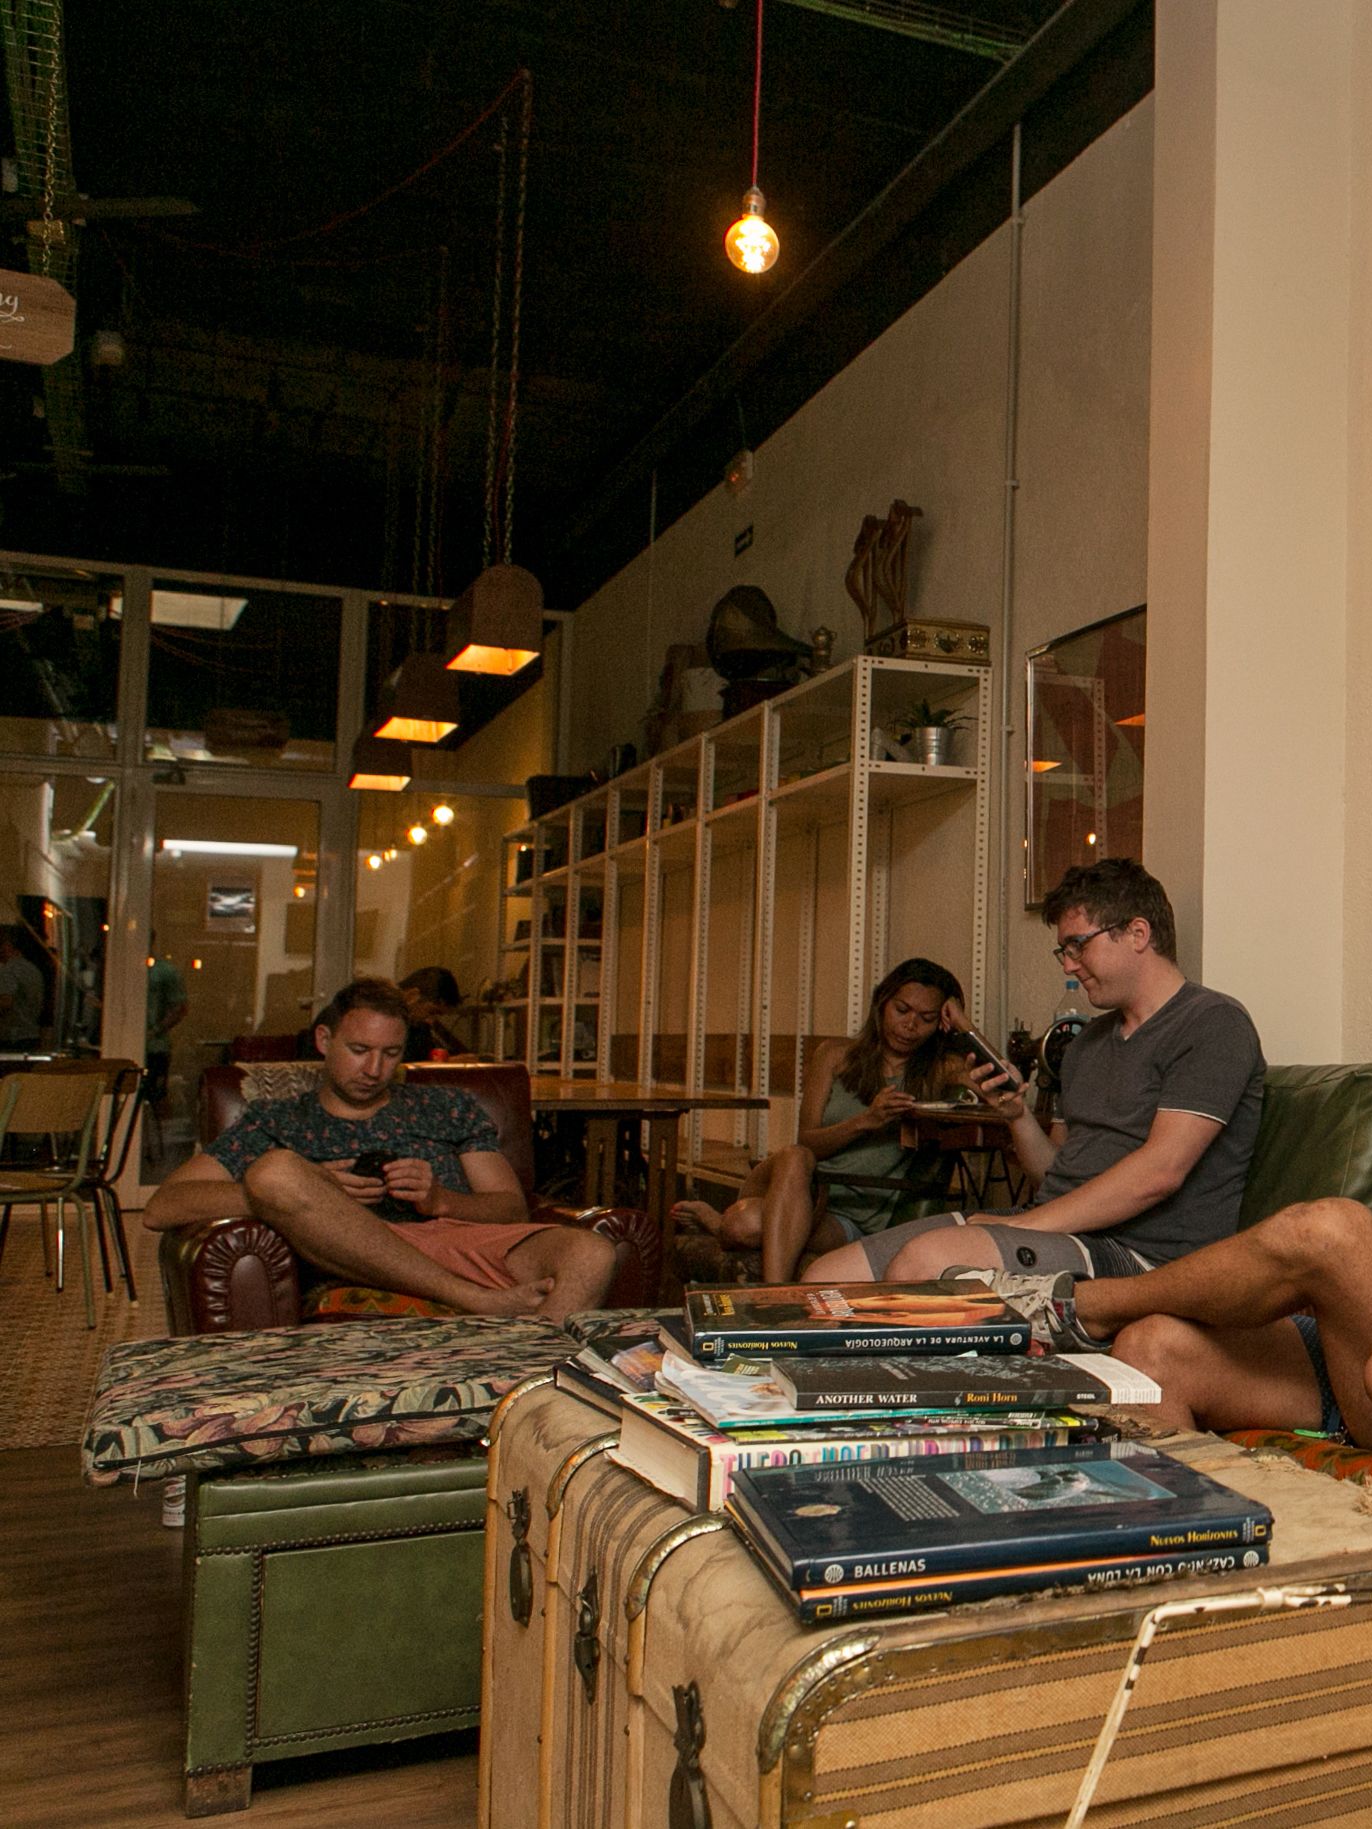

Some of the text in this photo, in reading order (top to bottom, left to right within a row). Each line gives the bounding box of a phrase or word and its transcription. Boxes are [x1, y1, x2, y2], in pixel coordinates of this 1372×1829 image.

[845, 1335, 1005, 1350] LA AVENTURA DE LA ARQUEOLOGÍA
[815, 1393, 918, 1405] ANOTHER WATER
[966, 1392, 1018, 1403] Roni Horn
[854, 1558, 926, 1579] BALLENAS
[1125, 1568, 1142, 1579] LA
[1146, 1563, 1174, 1577] CON
[1087, 1571, 1121, 1584] LUNA
